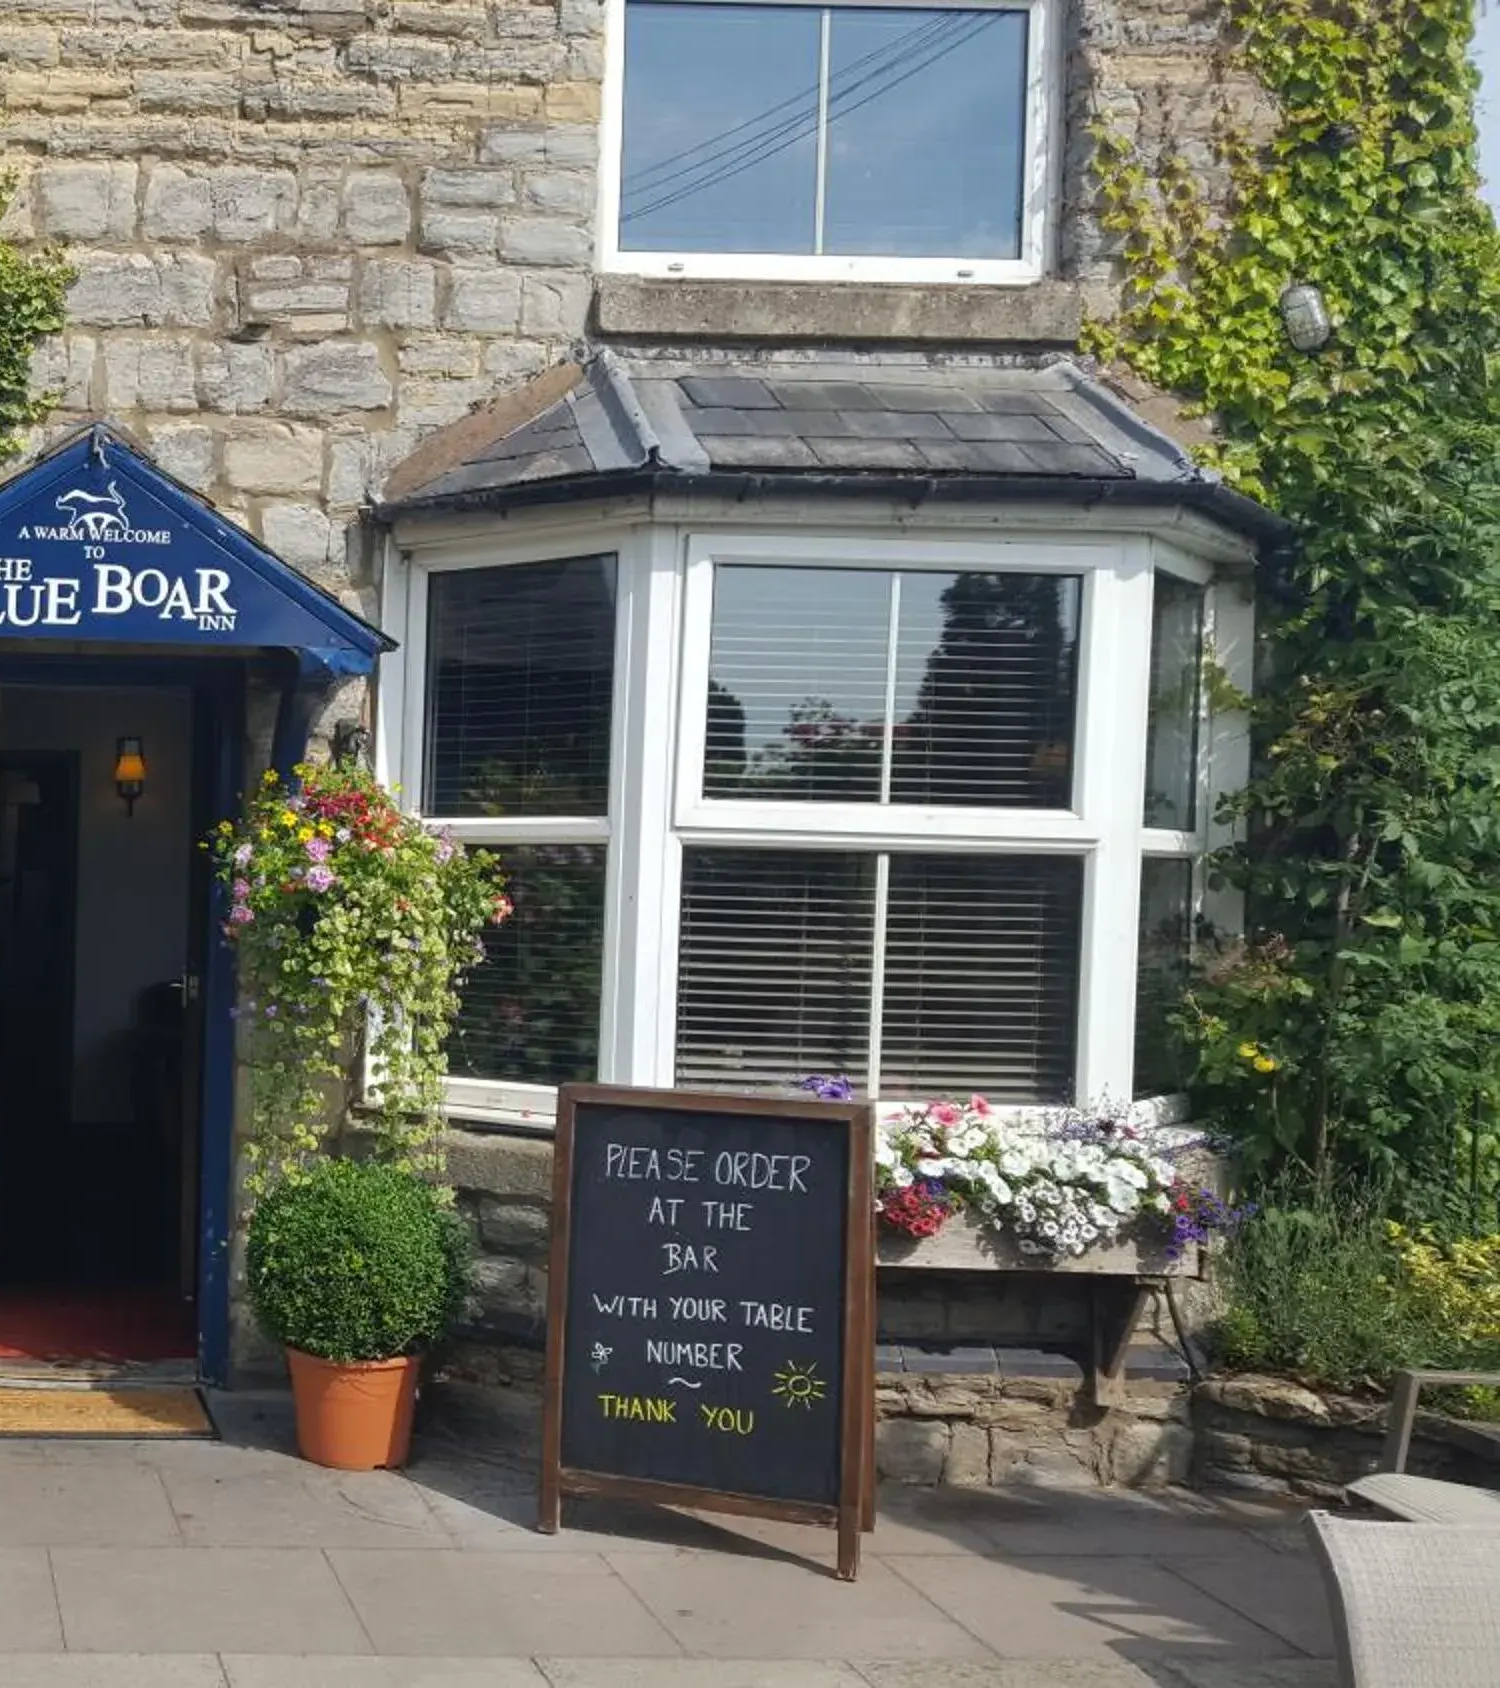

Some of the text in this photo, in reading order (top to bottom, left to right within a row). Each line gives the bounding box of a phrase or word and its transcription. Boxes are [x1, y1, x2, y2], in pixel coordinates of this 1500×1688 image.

[18, 527, 171, 545] A WARM WELCOME
[84, 546, 105, 560] TO
[92, 564, 237, 621] BOAR
[199, 614, 236, 631] INN
[605, 1143, 811, 1193] PLEASE ORDER
[648, 1197, 755, 1232] AT THE
[661, 1243, 719, 1276] BAR
[593, 1294, 815, 1333] WITH YOUR TABLE
[646, 1339, 744, 1372] NUMBER
[598, 1395, 755, 1435] THANK YOU
